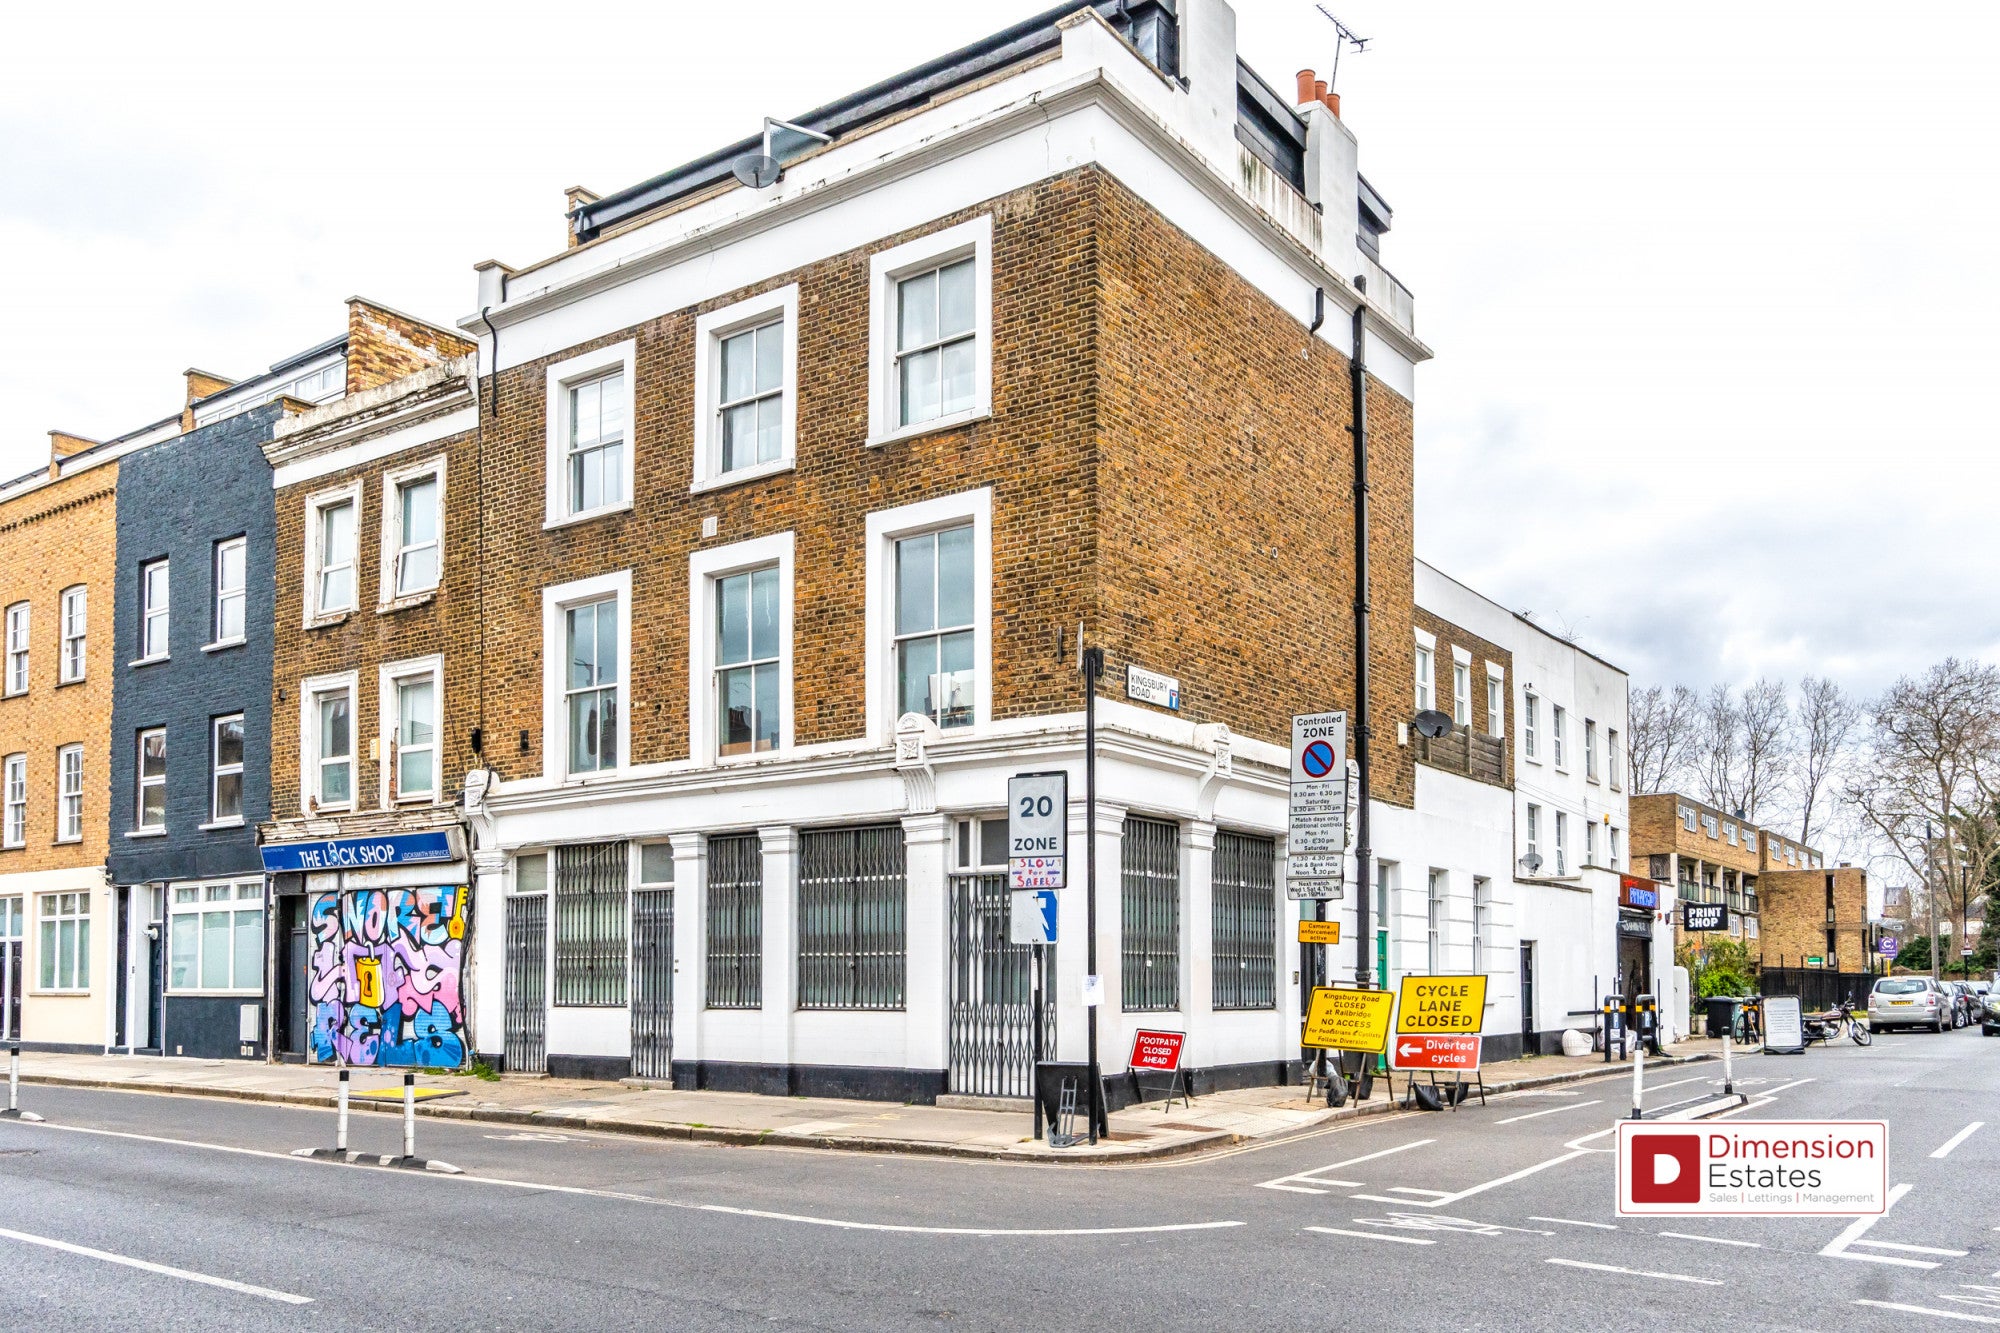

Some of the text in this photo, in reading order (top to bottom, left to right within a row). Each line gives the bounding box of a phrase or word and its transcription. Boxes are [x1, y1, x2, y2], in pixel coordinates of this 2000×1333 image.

[1131, 674, 1168, 693] KINGSBURY
[1131, 685, 1150, 699] ROAD
[1297, 715, 1342, 726] Controlled
[1303, 726, 1334, 738] ZONE
[1020, 796, 1053, 818] 20
[1014, 836, 1058, 851] ZONE
[298, 842, 395, 868] THE LOCK SHOP
[1020, 858, 1055, 868] SLOW
[1688, 907, 1722, 918] PRINT
[1689, 918, 1718, 928] SHOP
[1416, 986, 1469, 996] CYCLE
[1324, 993, 1358, 1002] Kingsbury
[1334, 1001, 1366, 1009] CLOSED
[1419, 1000, 1462, 1012] LANE
[1335, 1010, 1372, 1018] Railbridge
[1321, 1018, 1372, 1028] NO ACCESS
[1406, 1016, 1472, 1026] CLOSED
[1318, 1028, 1351, 1036] Pedestrians
[1140, 1036, 1180, 1046] FOOTPATH
[1426, 1040, 1474, 1050] Diverted
[1142, 1046, 1172, 1056] CLOSED
[1142, 1056, 1168, 1064] AHEAD
[1432, 1054, 1466, 1064] cycles
